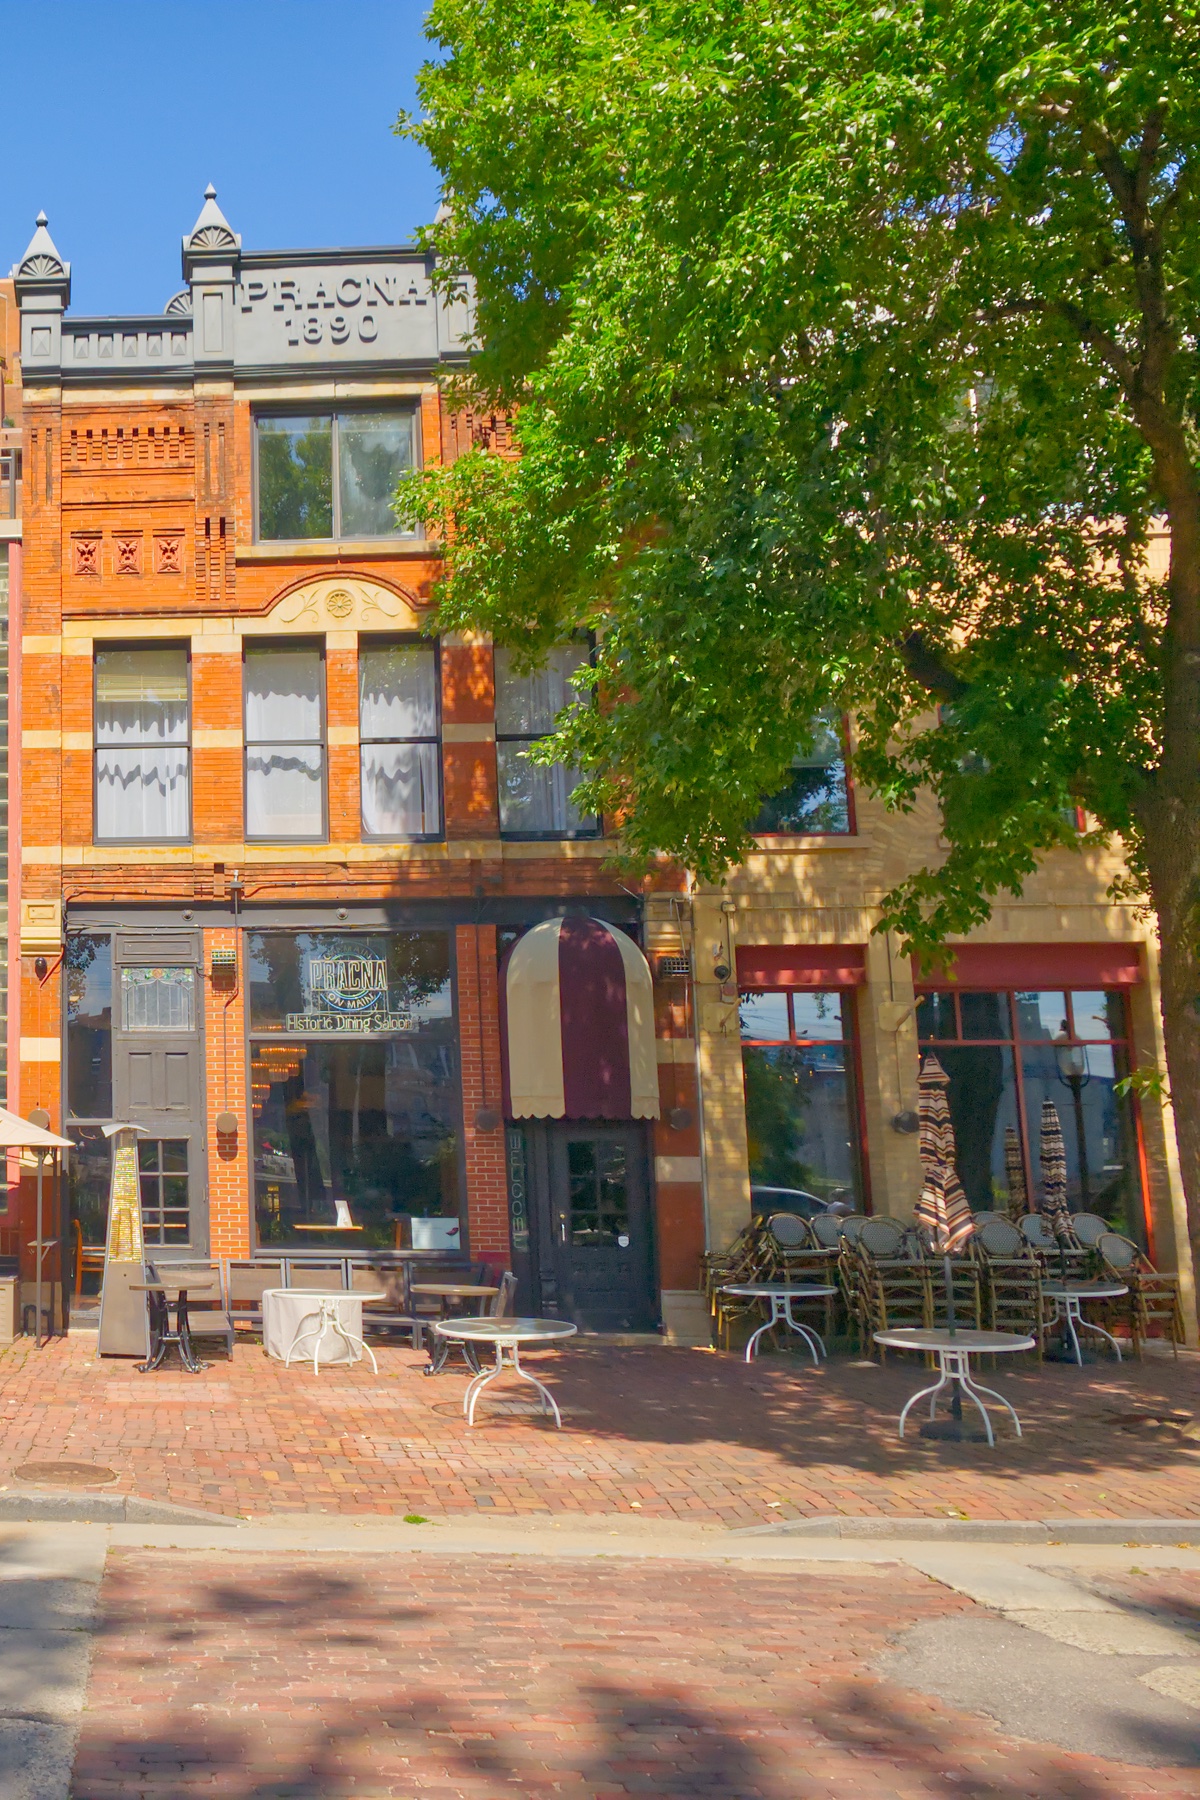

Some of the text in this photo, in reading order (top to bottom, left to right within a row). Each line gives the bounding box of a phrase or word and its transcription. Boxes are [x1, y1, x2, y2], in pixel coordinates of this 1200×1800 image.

[240, 274, 427, 313] PRACNA
[284, 314, 379, 347] 1890
[311, 961, 387, 990] PRACNA
[327, 993, 376, 1010] ON MAIN
[336, 1015, 371, 1033] Dining
[375, 1013, 413, 1030] Saloon
[509, 1134, 525, 1249] WELCOME
